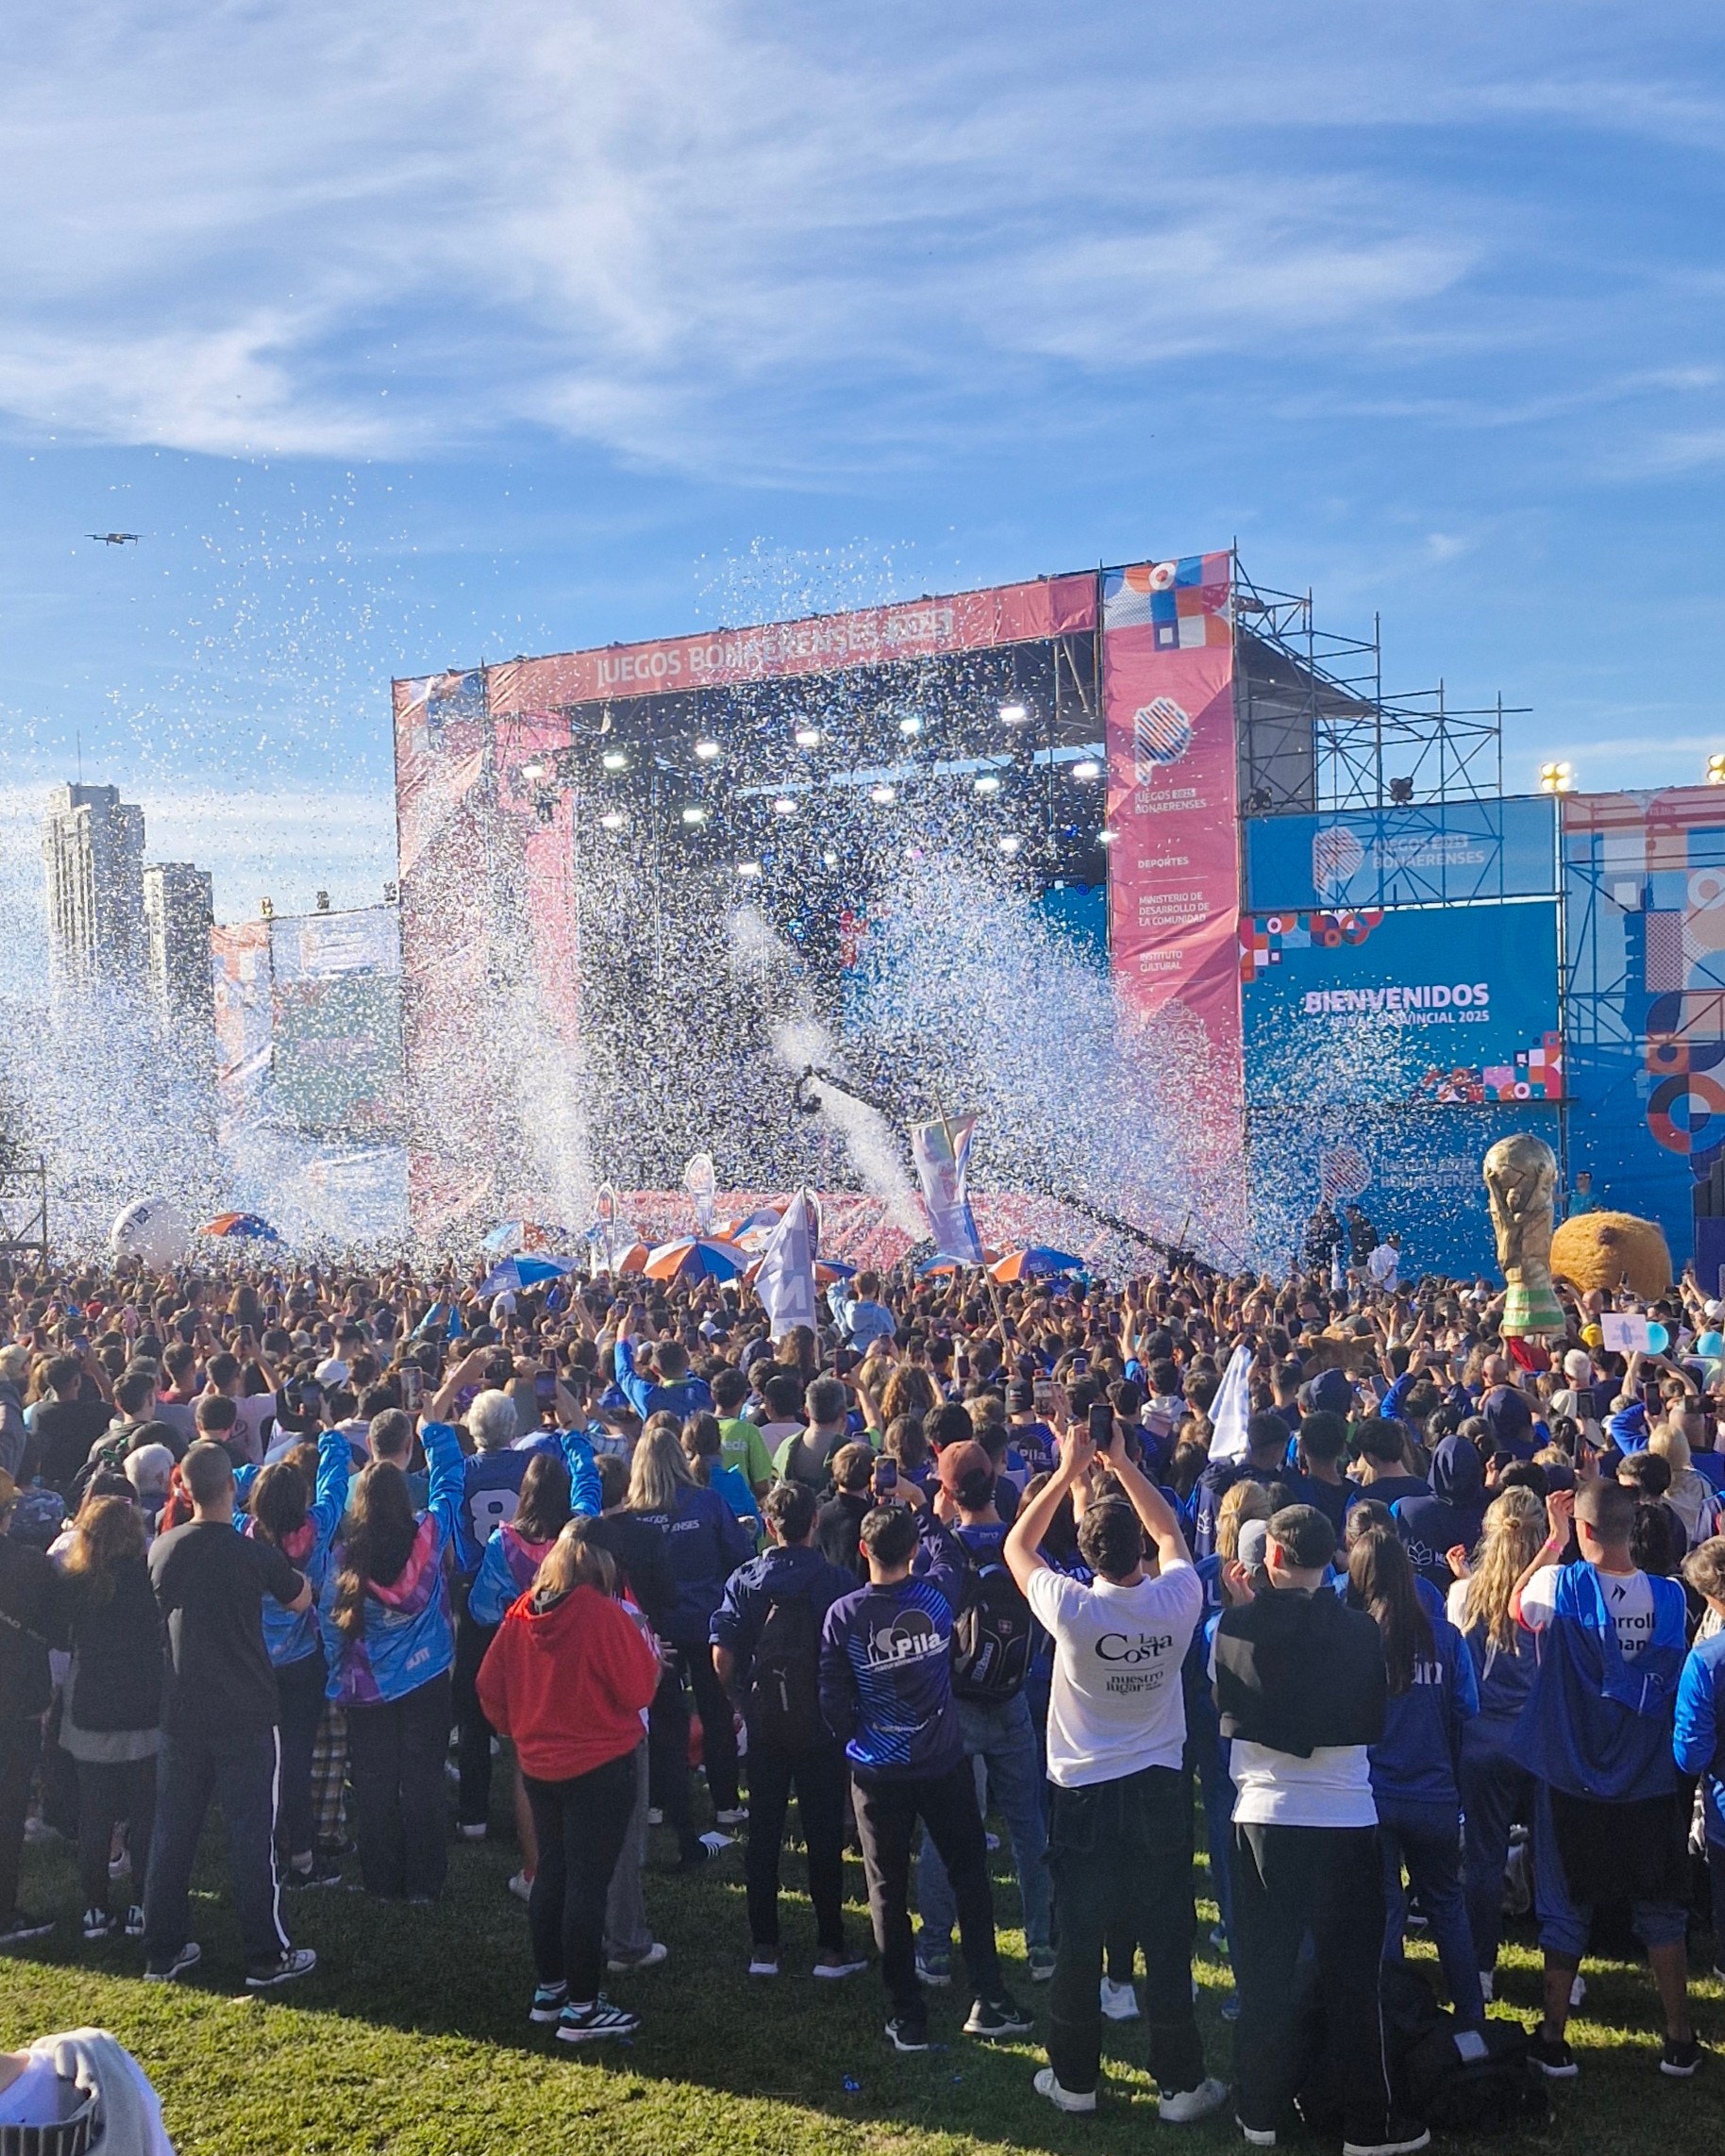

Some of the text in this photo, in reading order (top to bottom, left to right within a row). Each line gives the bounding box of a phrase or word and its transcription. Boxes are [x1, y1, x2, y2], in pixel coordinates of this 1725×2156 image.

[596, 649, 681, 690] JUEGOS
[1135, 790, 1171, 805] JUEGOS
[1135, 798, 1207, 814] BONAERENSES
[1373, 837, 1431, 854] JUEGOS
[1137, 857, 1189, 869] DEPORTES
[1372, 850, 1485, 869] BONAERENSES
[1139, 892, 1203, 905] MINISTERIO DE
[1139, 902, 1210, 915] DESARROLLO DE
[1138, 913, 1207, 927] LA COMUNIDAD
[1140, 950, 1182, 961] INSTITUTO
[1140, 961, 1182, 973] CULTURAL
[1305, 982, 1490, 1013] BIENVENIDOS
[1459, 1010, 1490, 1022] 2025
[1020, 1449, 1047, 1461] Pila
[896, 1632, 941, 1659] Pila
[1096, 1633, 1173, 1663] Costa
[1111, 1671, 1164, 1684] nuestro
[1106, 1680, 1144, 1696] lugar
